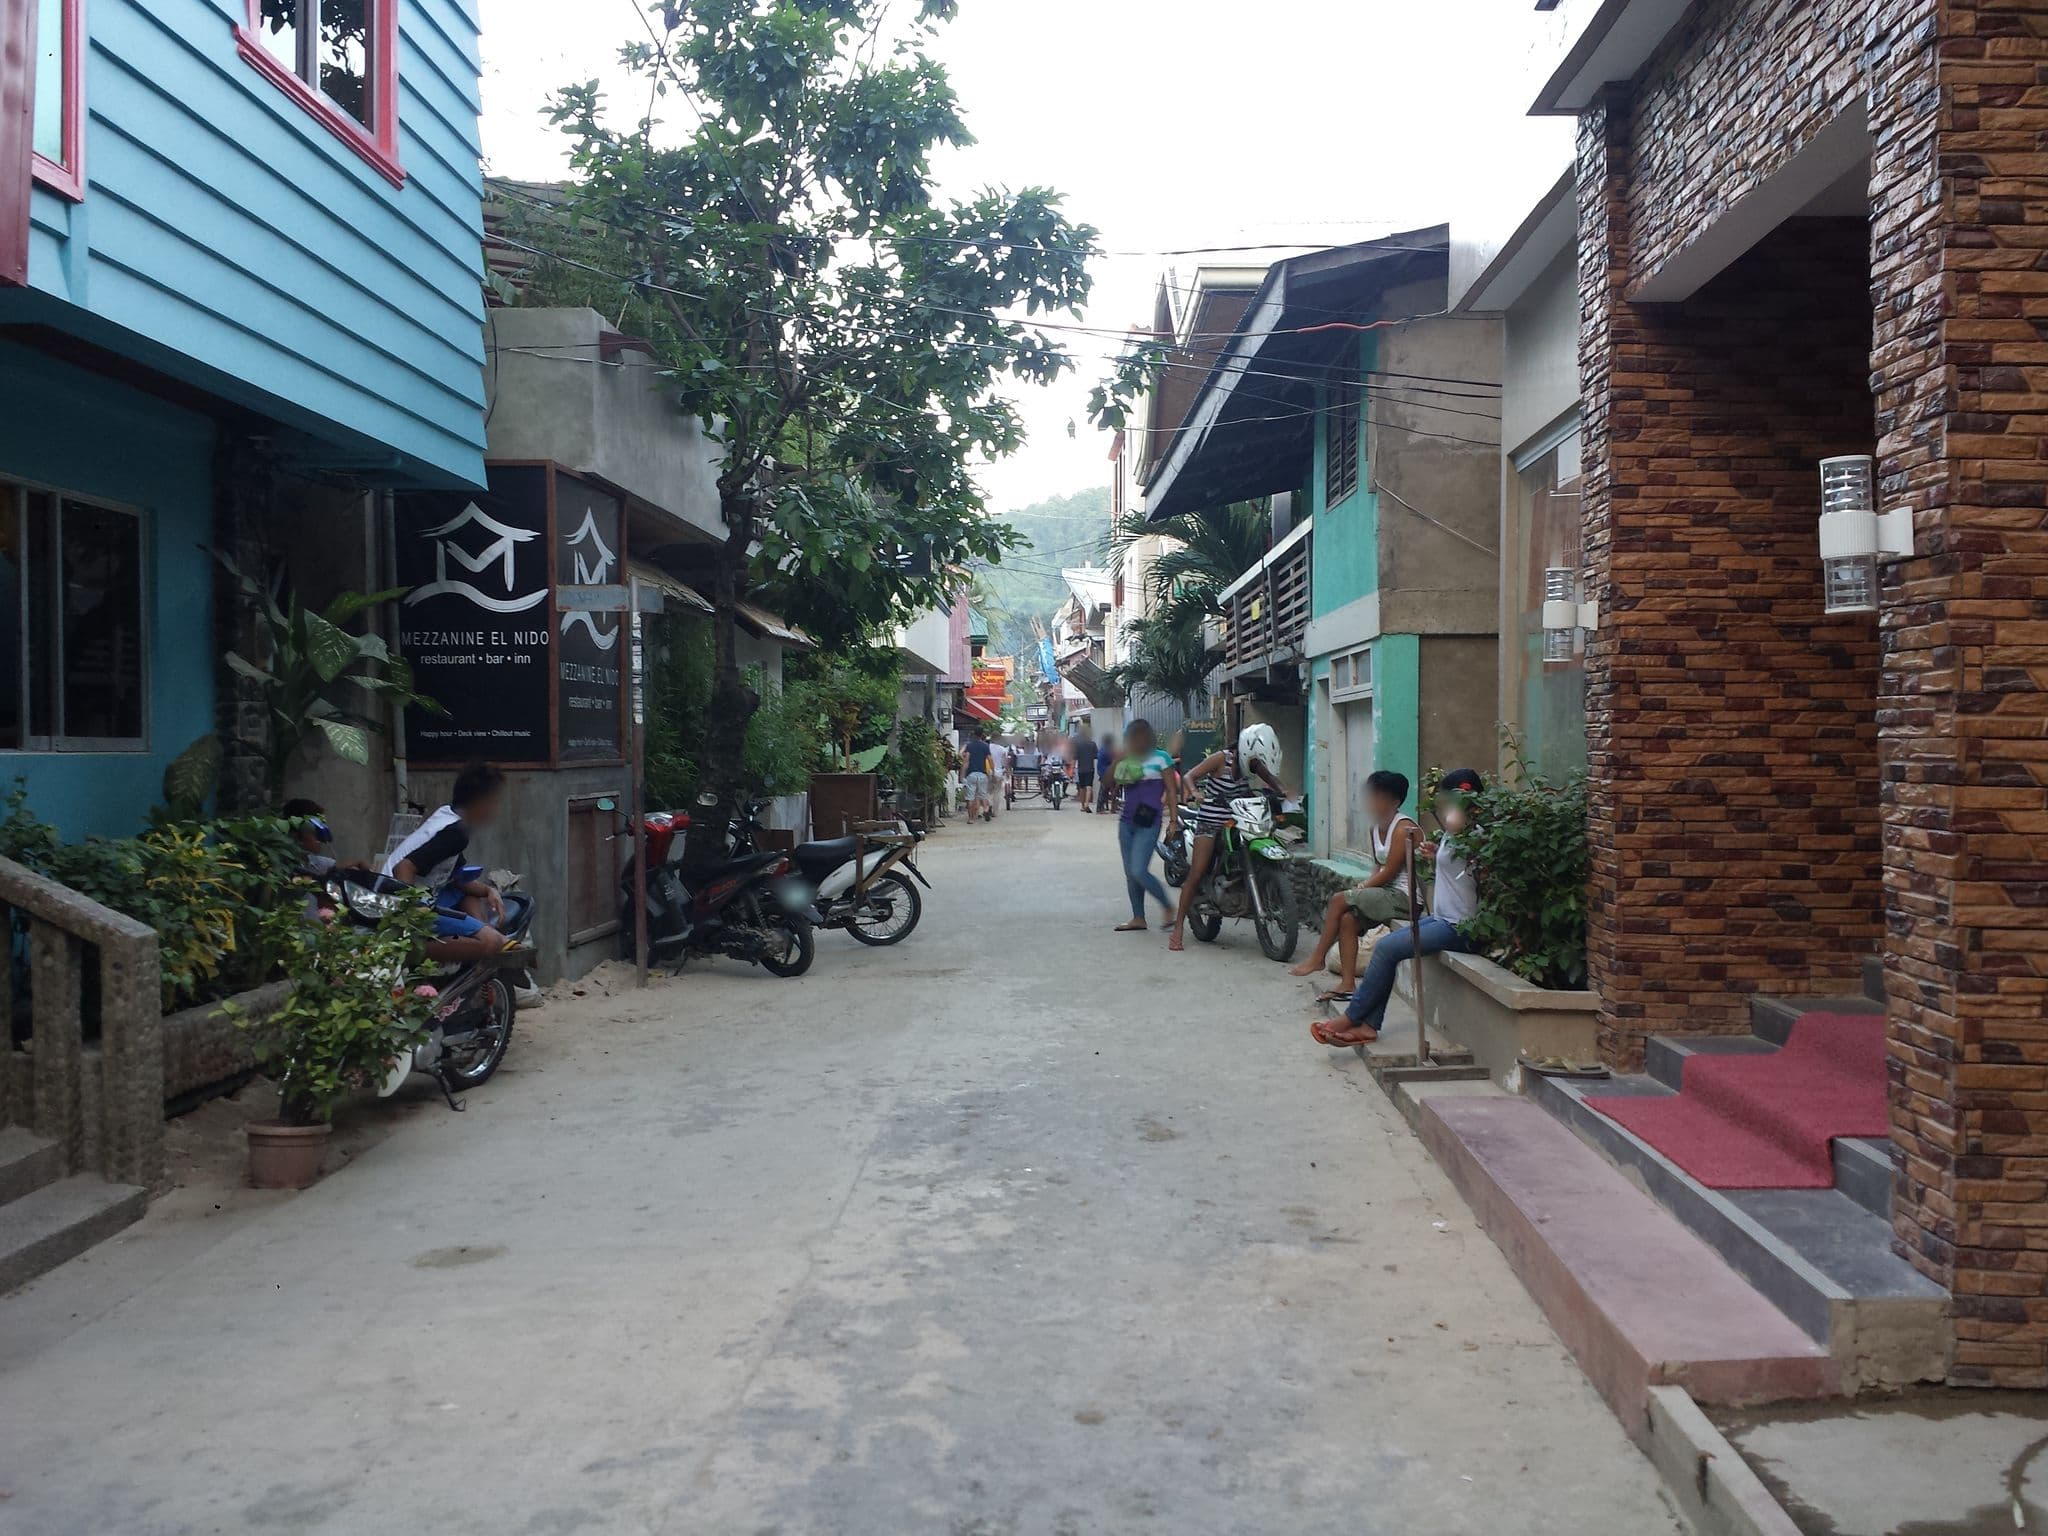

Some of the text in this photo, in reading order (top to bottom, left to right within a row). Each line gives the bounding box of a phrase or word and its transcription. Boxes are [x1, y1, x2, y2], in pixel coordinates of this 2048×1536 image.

[400, 630, 550, 645] MEZZANINE EL NIDO
[420, 651, 532, 665] restaurant bar inn
